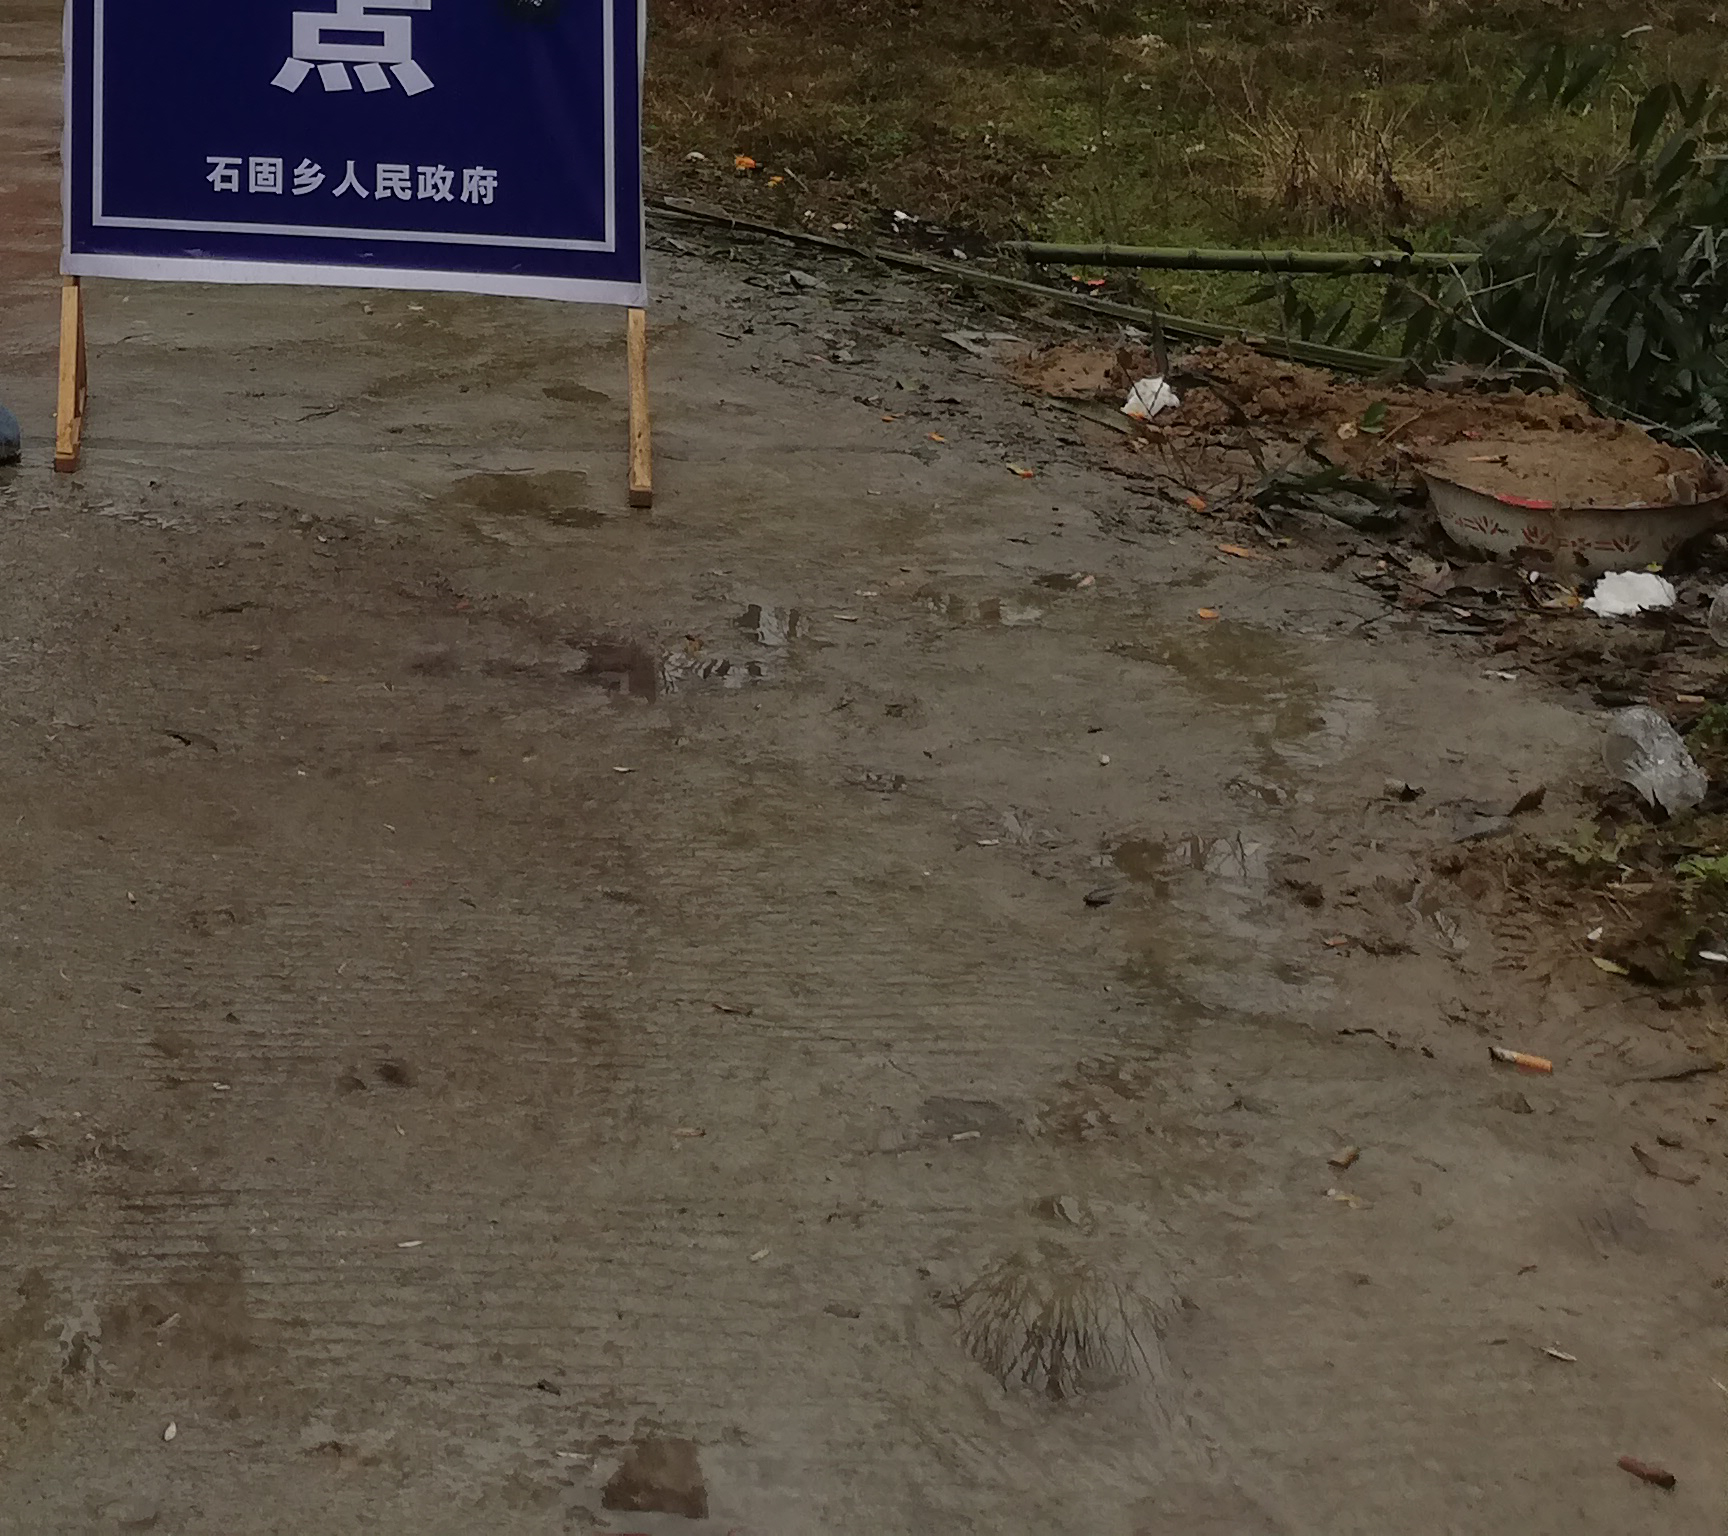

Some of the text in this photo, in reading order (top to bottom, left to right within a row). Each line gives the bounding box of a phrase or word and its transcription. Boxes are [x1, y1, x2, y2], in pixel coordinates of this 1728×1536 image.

[205, 154, 499, 207] 石固乡人民政府
